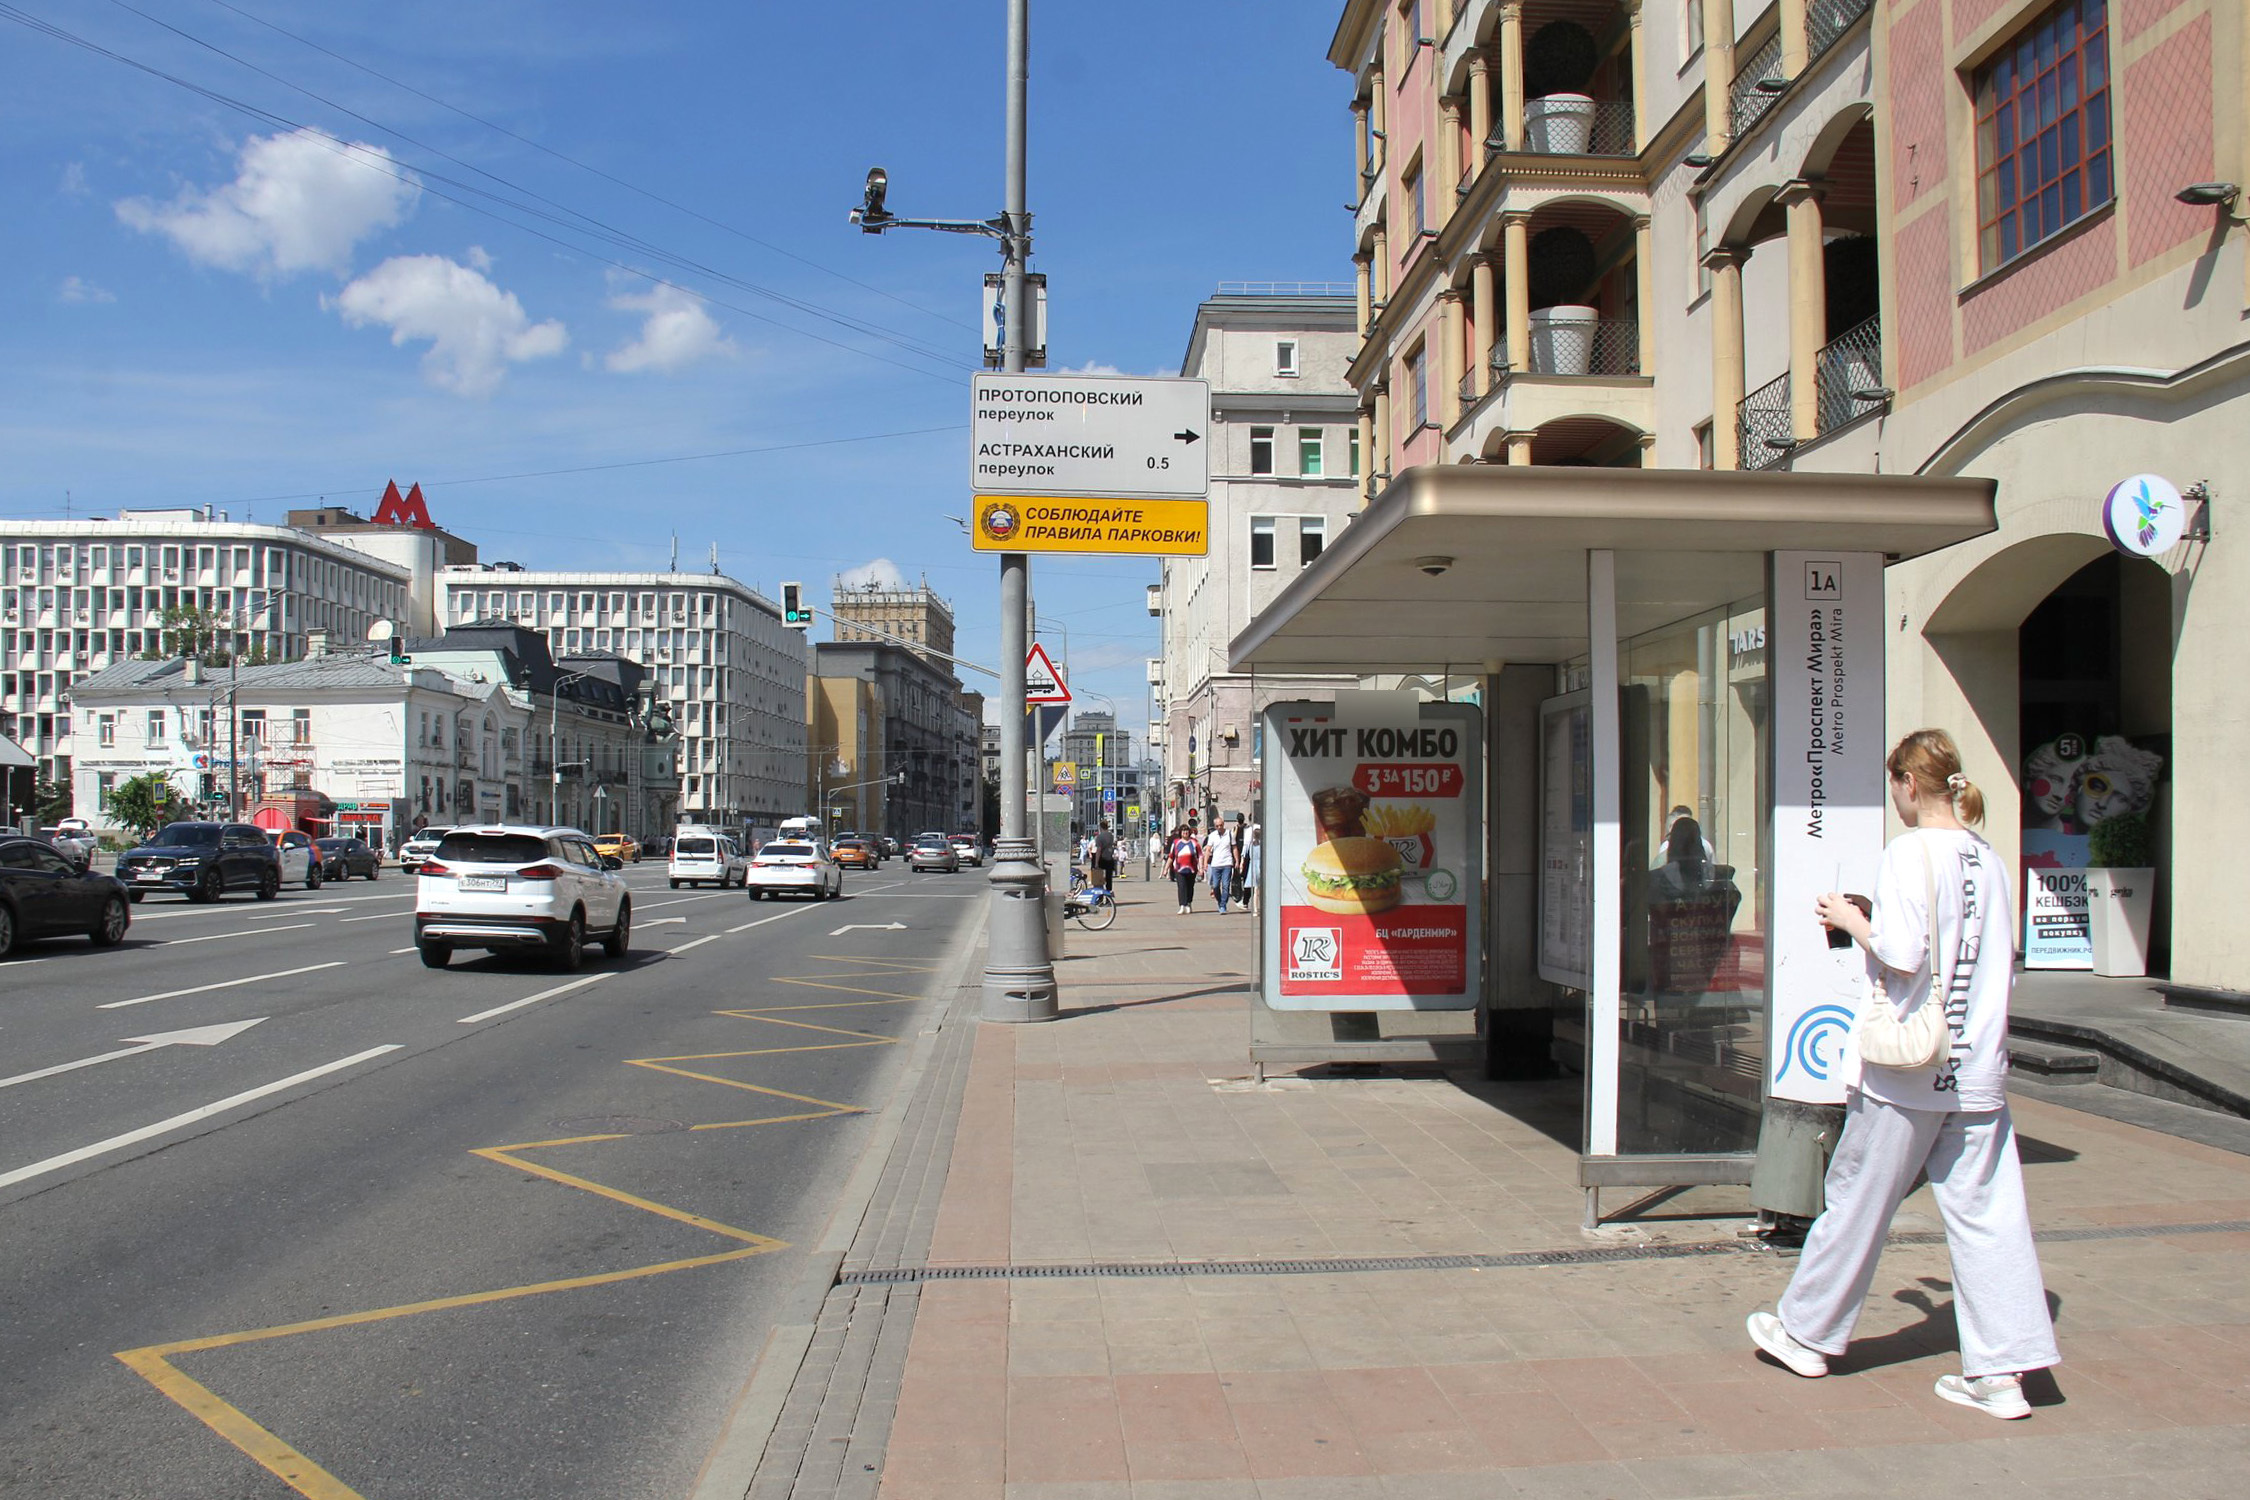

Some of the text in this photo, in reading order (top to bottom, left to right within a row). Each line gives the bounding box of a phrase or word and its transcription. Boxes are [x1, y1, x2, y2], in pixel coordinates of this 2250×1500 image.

[979, 389, 1143, 406] ПРОТОПОПОВСКИЙ
[979, 408, 1054, 422] переулок
[978, 443, 1114, 459] АСТРАХАНСКИЙ
[979, 463, 1054, 477] переулок
[1146, 456, 1169, 470] 0.5
[1025, 507, 1143, 524] СОБЛЮДАЙТЕ
[1024, 526, 1200, 543] ПРАВИЛА ПАРКОВКИ!
[1807, 608, 1826, 673] Мира»
[1830, 608, 1846, 755] Metro Prospekt Mira
[1290, 728, 1458, 758] ХИТ КОМБО
[1402, 769, 1439, 792] 150
[1959, 845, 1982, 919] Los
[2037, 874, 2087, 892] 100%
[2035, 896, 2088, 908] КЕШБЭК
[1376, 928, 1389, 940] БЦ
[1291, 971, 1340, 979] ROSTIC'S
